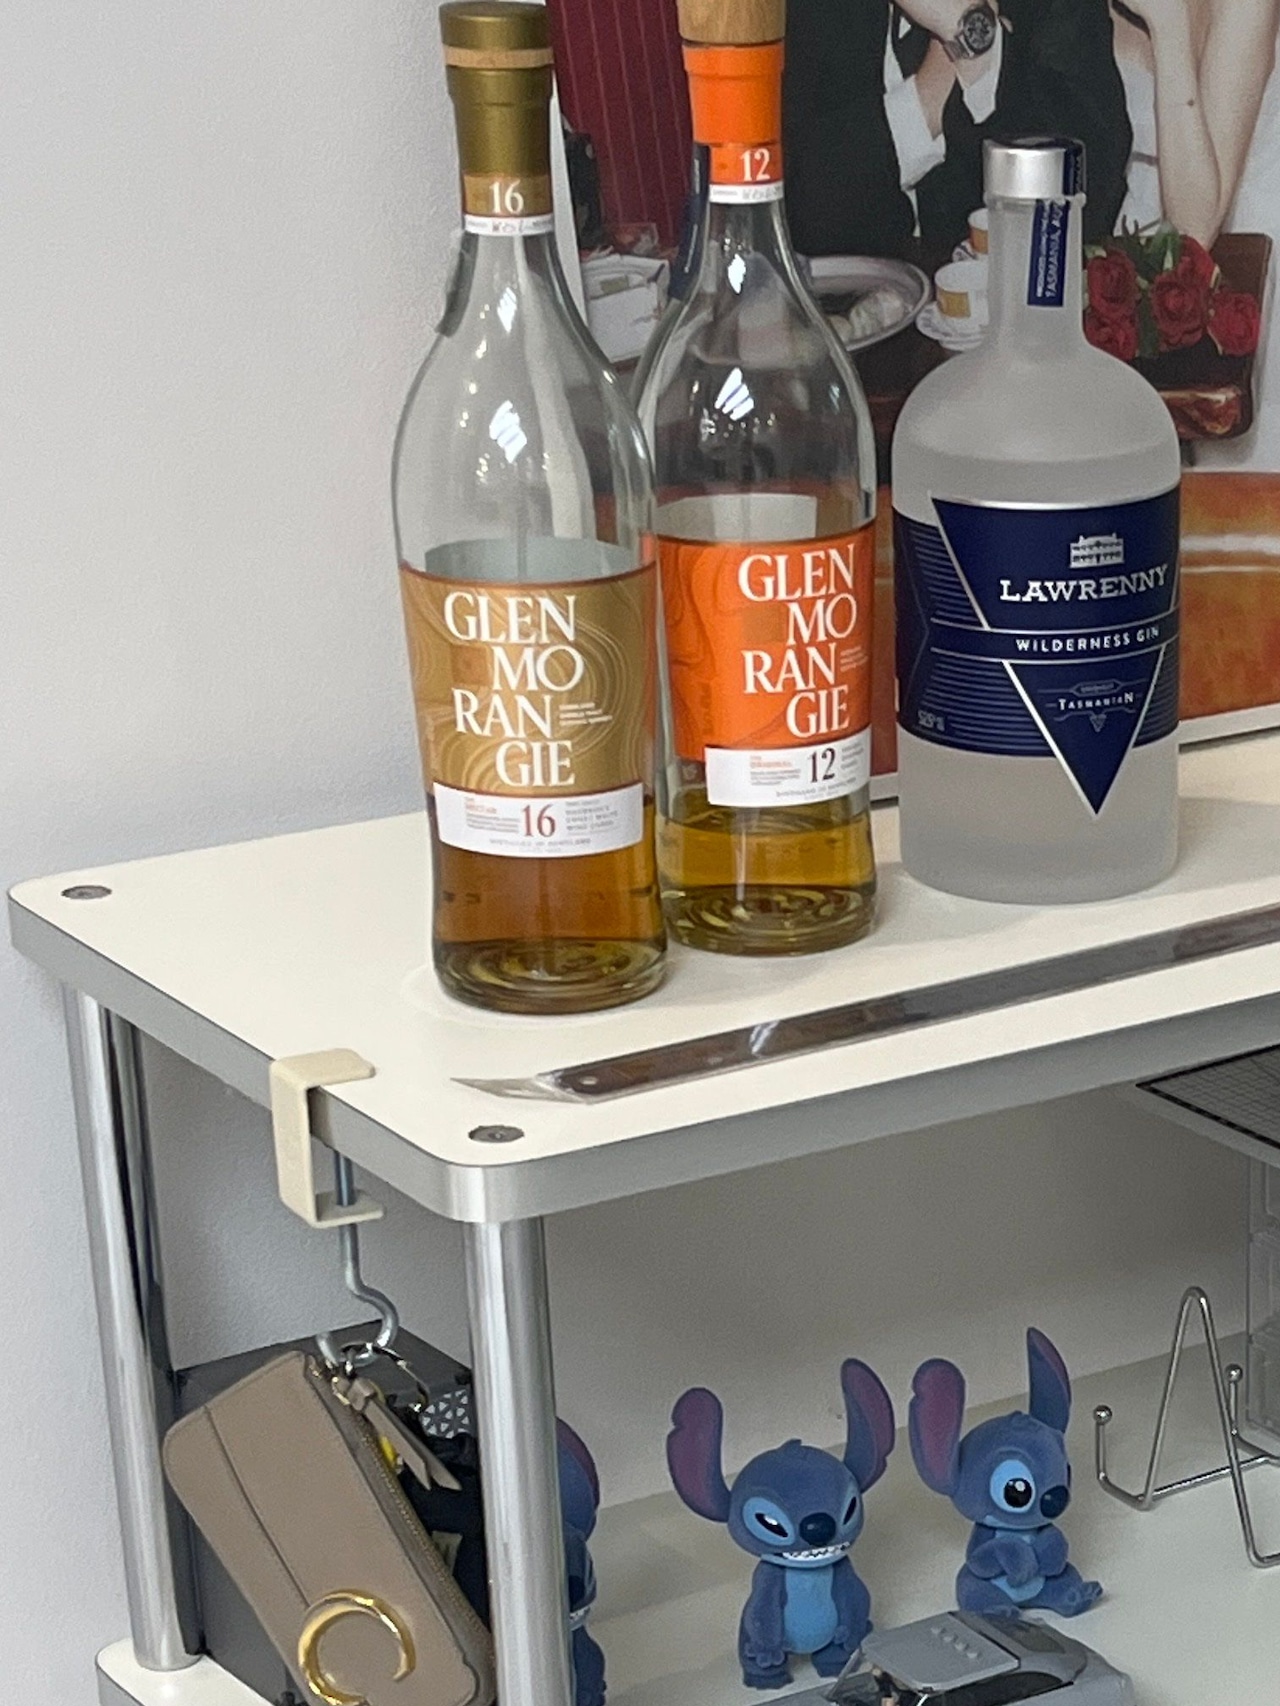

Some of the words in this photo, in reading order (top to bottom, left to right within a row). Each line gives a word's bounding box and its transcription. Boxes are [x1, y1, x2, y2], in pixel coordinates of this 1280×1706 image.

[740, 148, 771, 182] 12
[489, 180, 524, 214] 16
[738, 544, 855, 602] GLEN
[999, 563, 1168, 602] LAWRENNY
[444, 591, 576, 644] GLEN
[786, 593, 857, 647] MO
[1016, 634, 1130, 652] WILDERNESS
[1136, 626, 1160, 642] GIN
[491, 645, 585, 692] MO
[741, 642, 837, 694] RAN
[451, 688, 553, 739] RAN
[786, 685, 850, 738] GIE
[495, 739, 576, 787] GIE
[807, 747, 836, 783] 12
[521, 803, 557, 838] 16
